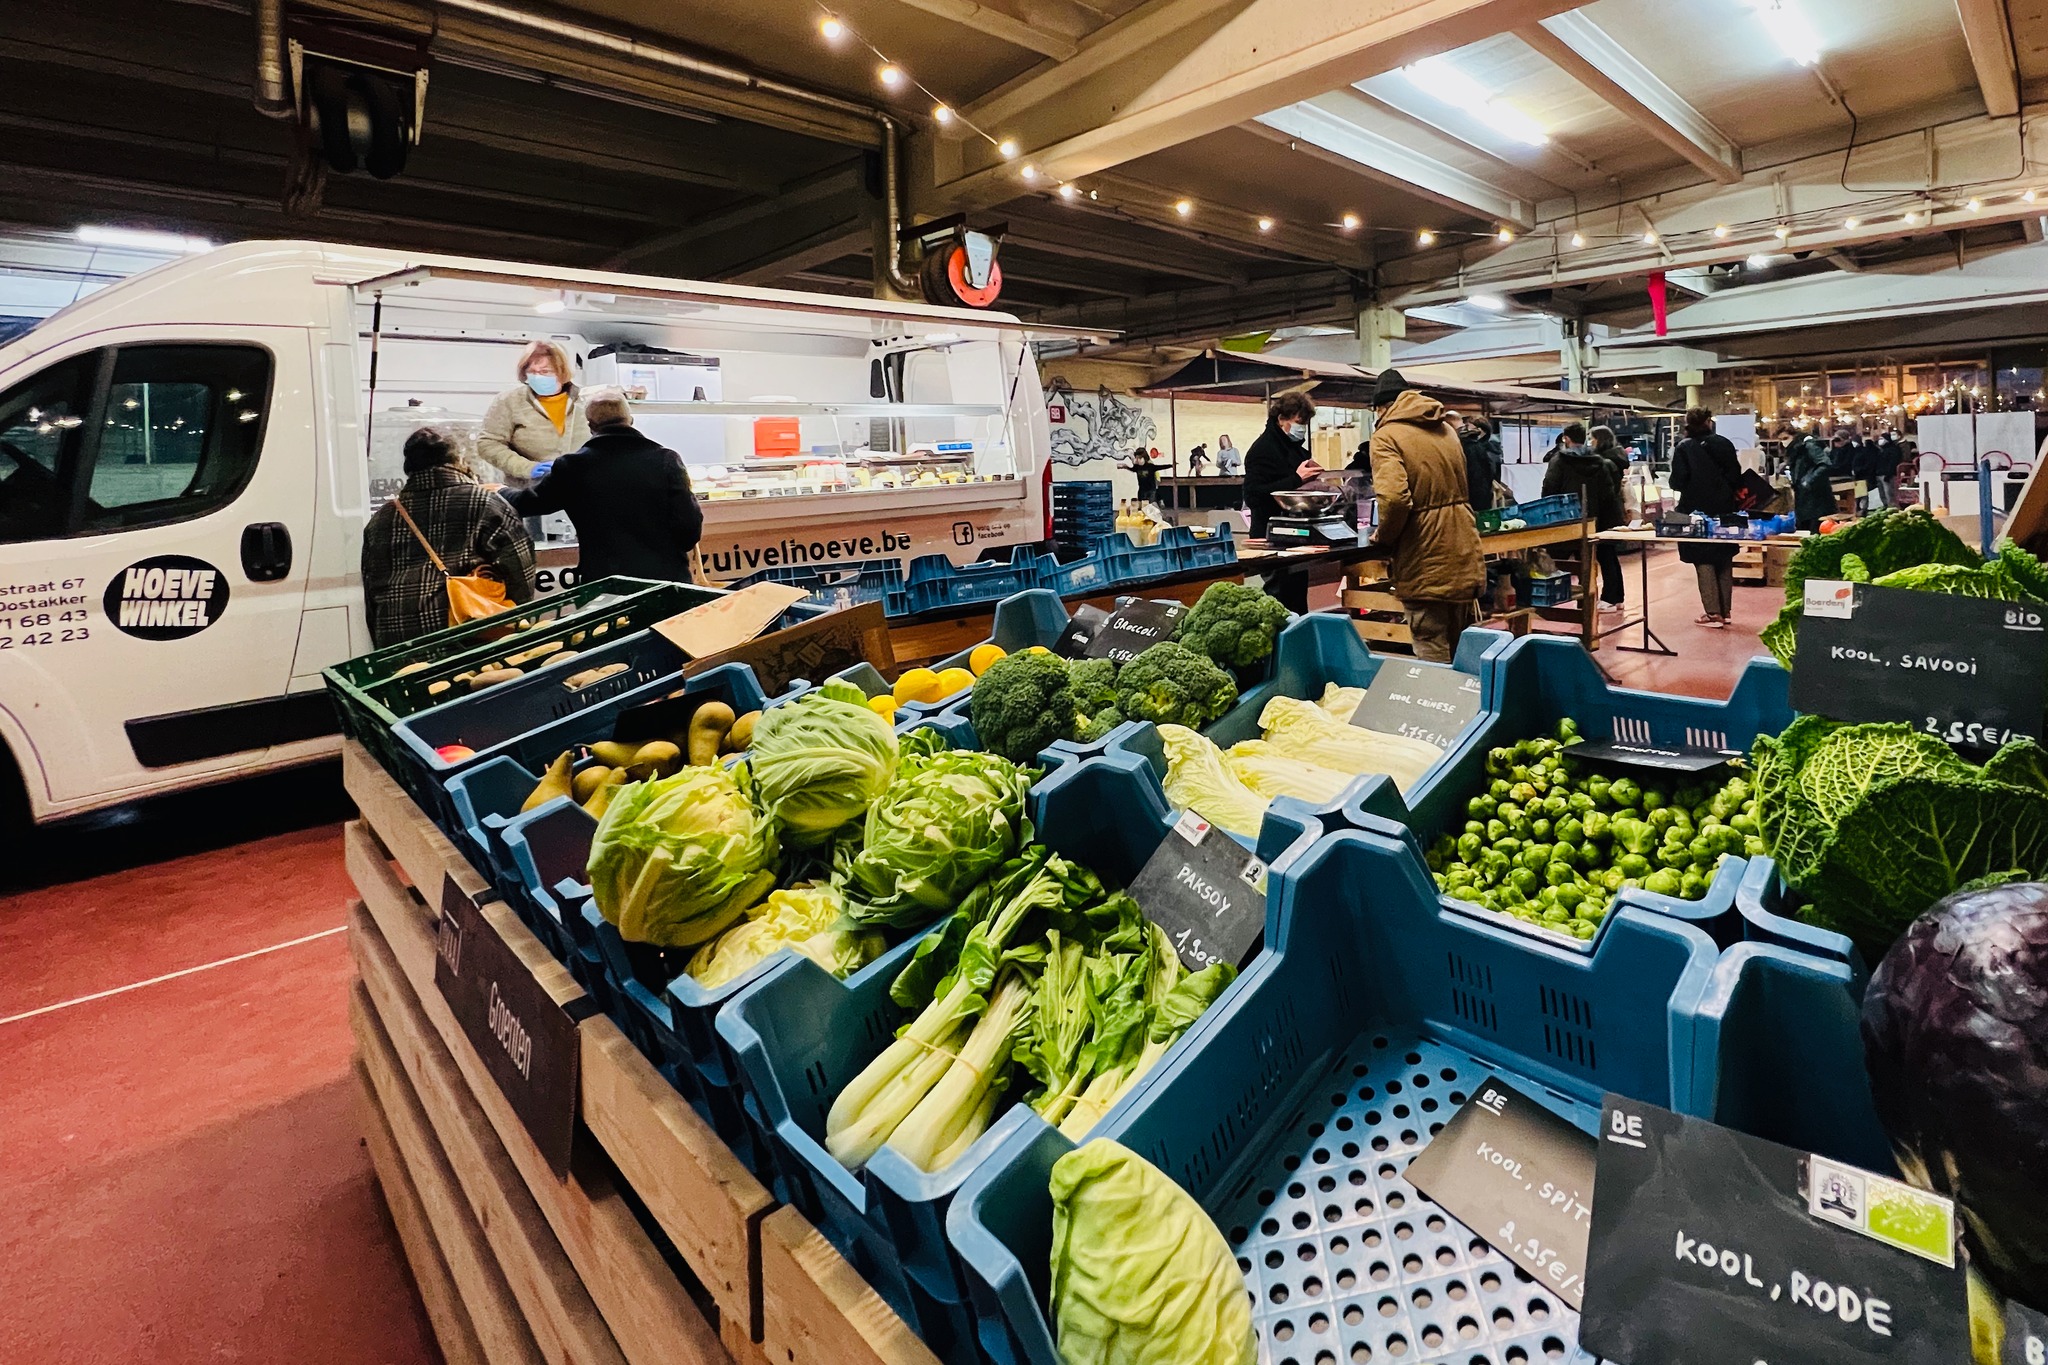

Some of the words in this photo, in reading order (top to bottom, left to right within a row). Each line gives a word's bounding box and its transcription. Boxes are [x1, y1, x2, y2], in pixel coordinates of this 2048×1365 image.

[62, 578, 85, 590] 67
[123, 568, 216, 599] HOEVE
[0, 618, 12, 630] 1
[20, 613, 51, 628] 68
[59, 609, 88, 622] 43
[120, 601, 209, 627] WINKEL
[22, 632, 53, 646] 42
[61, 628, 90, 642] 23
[1389, 692, 1412, 704] KOOL
[1177, 865, 1231, 917] PAKSOY
[488, 981, 532, 1081] Groenten
[1482, 1088, 1508, 1111] BE
[1611, 1109, 1643, 1138] BE
[1539, 1182, 1590, 1229] SPIT
[1790, 1271, 1893, 1337] RODE
